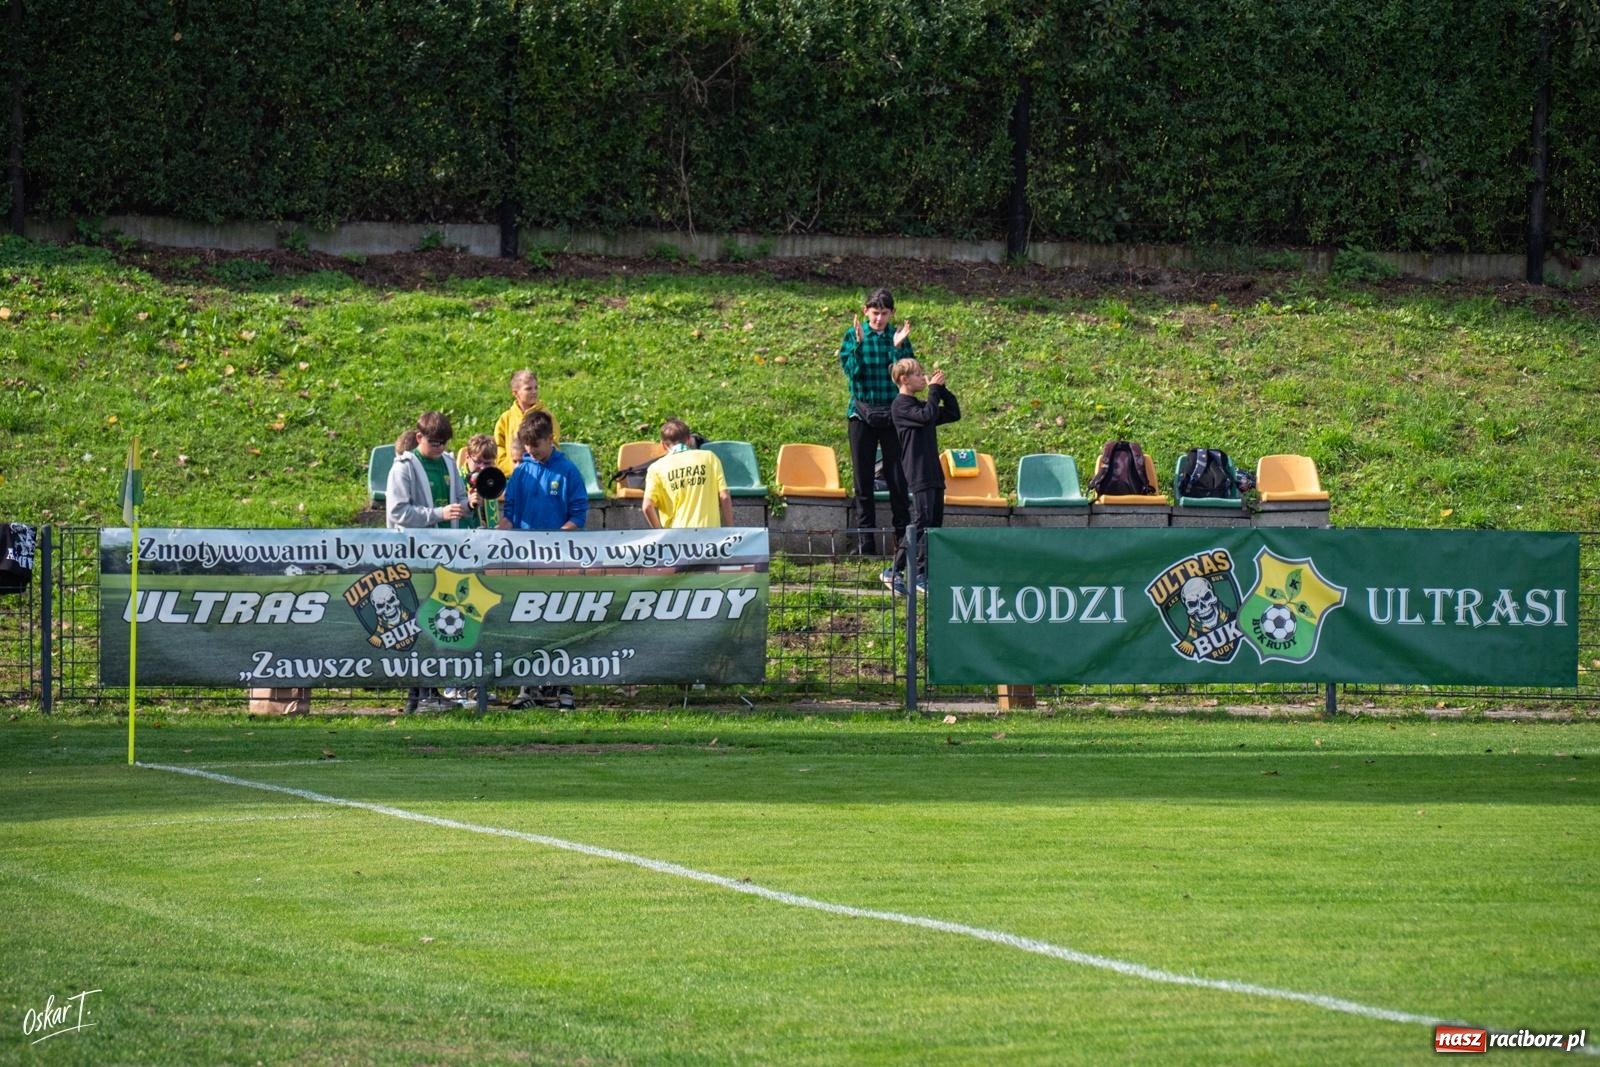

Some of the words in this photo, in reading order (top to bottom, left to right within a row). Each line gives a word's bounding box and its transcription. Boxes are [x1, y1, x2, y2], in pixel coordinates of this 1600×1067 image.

[668, 464, 706, 482] ULTRAS
[336, 537, 365, 567] by
[373, 537, 479, 567] walczyć,
[487, 537, 561, 563] zdolni
[568, 539, 598, 567] by
[345, 563, 411, 606] ULTRAS
[1150, 551, 1231, 605] ULTRAS
[122, 590, 330, 624] ULTRAS
[510, 590, 614, 622] BUK
[620, 587, 758, 621] RUDY
[948, 586, 1128, 624] MŁODZI
[1366, 587, 1568, 628] ULTRASI
[380, 618, 422, 649] BUK
[439, 631, 465, 643] RUDY
[1193, 619, 1243, 658] BUK
[1252, 618, 1268, 645] BUK
[1267, 637, 1298, 651] RUDY
[380, 651, 482, 680] wierni
[493, 651, 503, 677] i
[1212, 642, 1235, 659] RUDY
